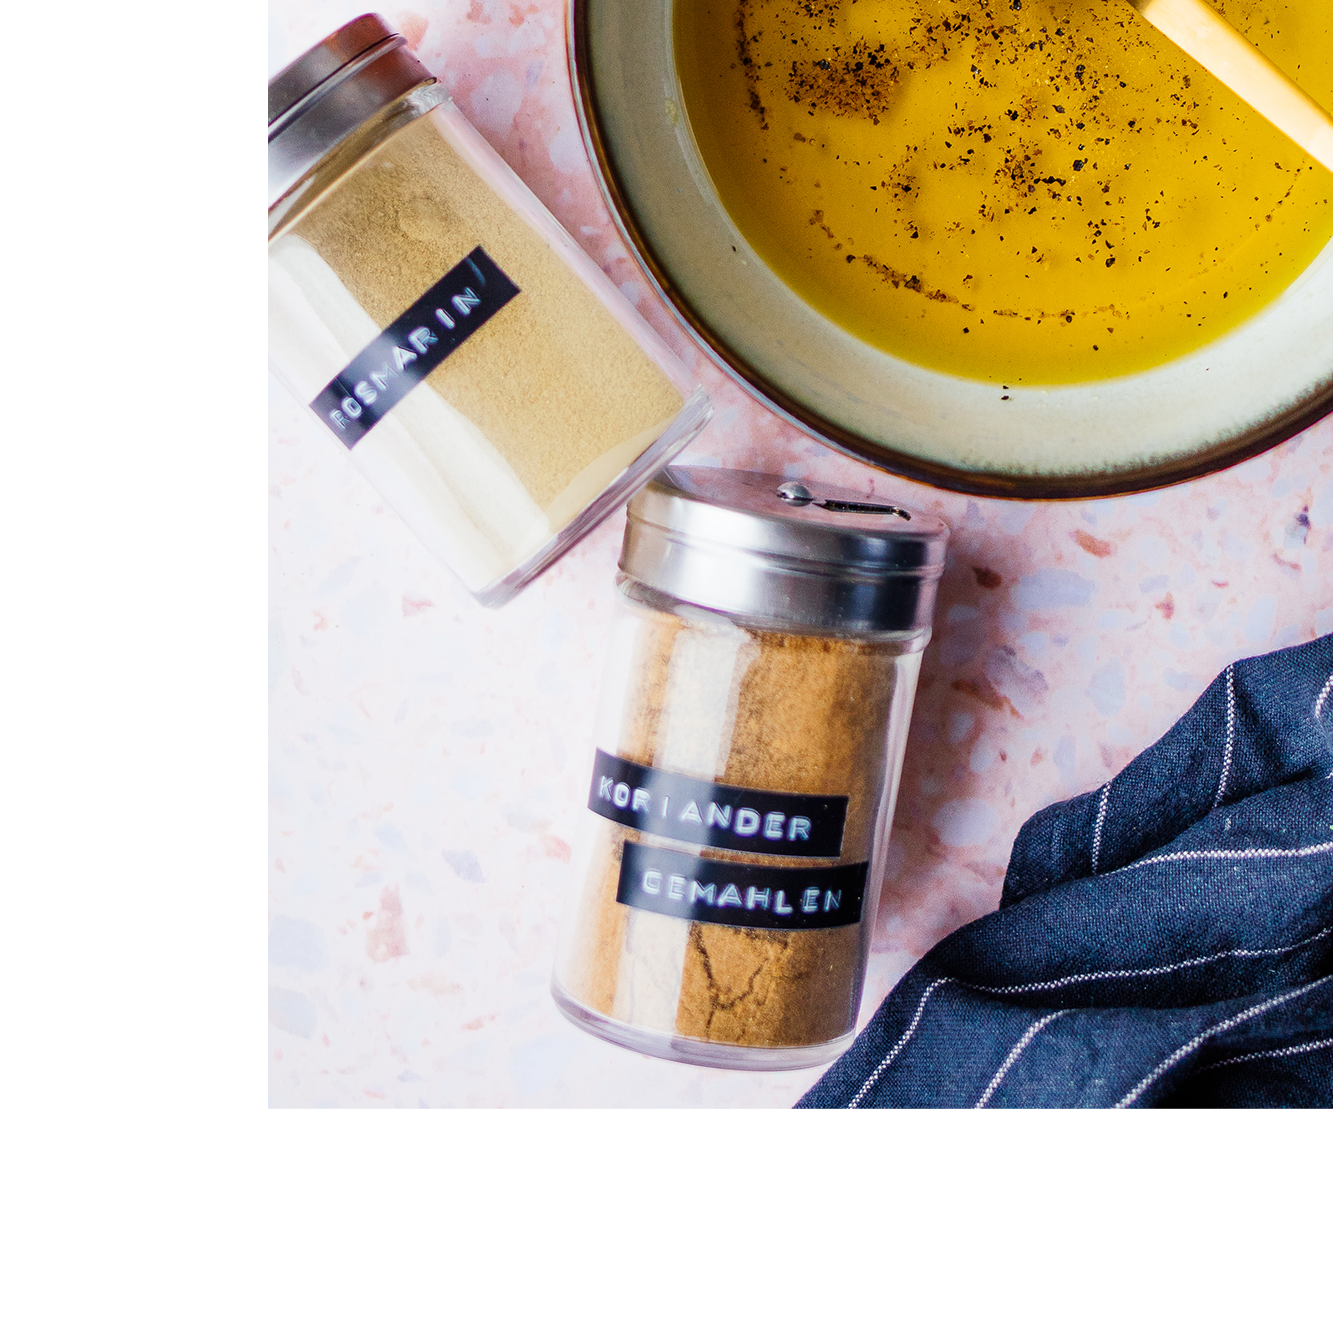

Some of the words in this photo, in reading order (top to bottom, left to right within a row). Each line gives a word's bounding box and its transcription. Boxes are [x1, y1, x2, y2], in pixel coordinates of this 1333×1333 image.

[329, 286, 482, 430] ROSMARIN
[599, 775, 812, 841] KORIANDER
[642, 868, 842, 915] GEMAHLEN
